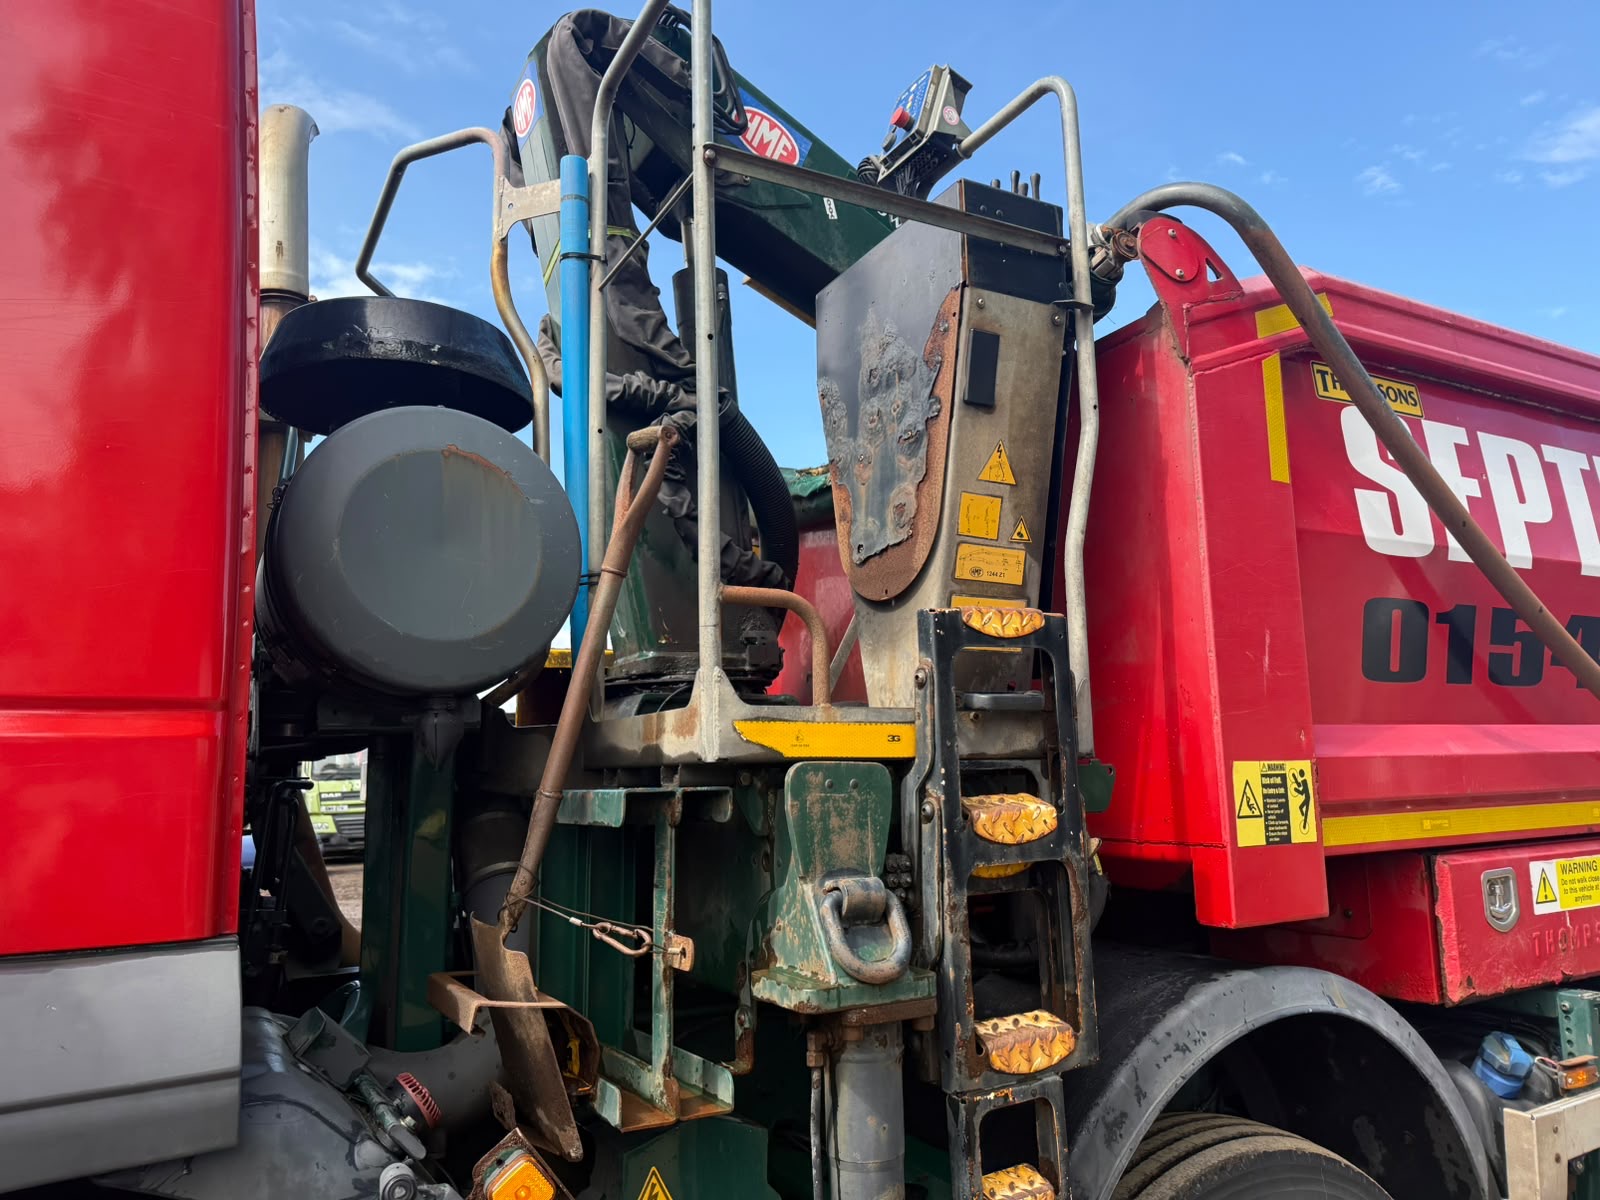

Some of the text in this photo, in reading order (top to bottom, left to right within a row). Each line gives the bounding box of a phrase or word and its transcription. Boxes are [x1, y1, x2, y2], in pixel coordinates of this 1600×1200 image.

[514, 85, 532, 131] HMF
[745, 112, 793, 161] HMF
[1316, 369, 1418, 407] THSONS
[1341, 405, 1600, 577] SEPT
[1560, 860, 1598, 875] WARNING
[1561, 878, 1568, 886] Do
[1577, 876, 1587, 884] walk
[1575, 894, 1592, 903] anytime
